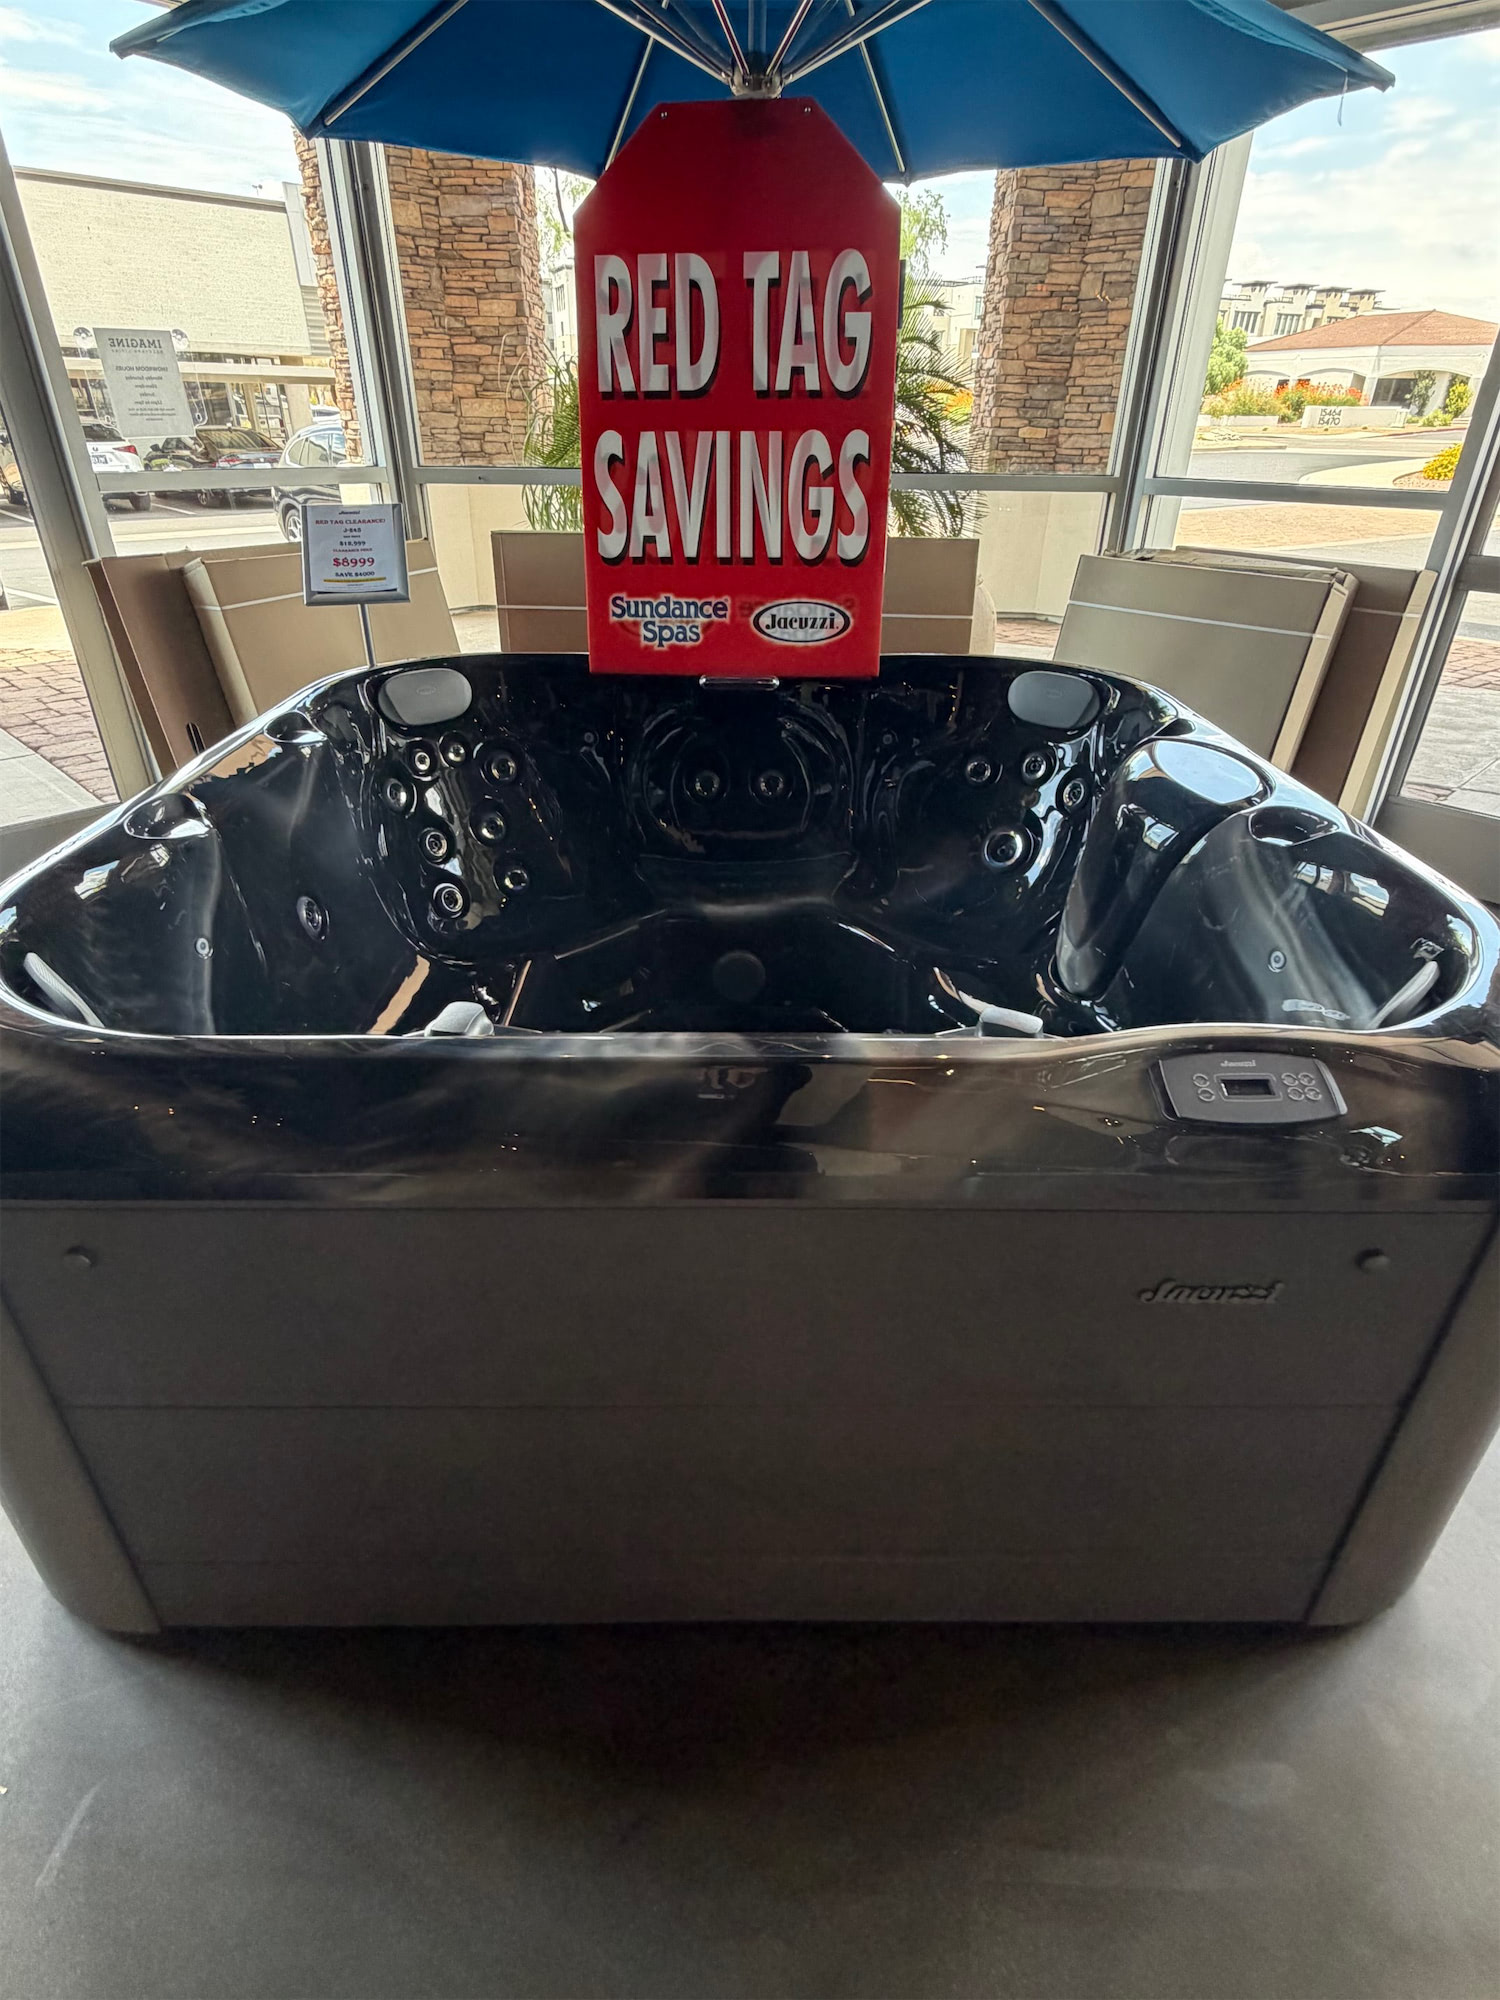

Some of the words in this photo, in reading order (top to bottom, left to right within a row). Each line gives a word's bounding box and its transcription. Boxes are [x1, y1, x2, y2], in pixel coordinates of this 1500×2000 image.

[594, 252, 721, 398] RED
[743, 248, 873, 398] TAG
[1318, 417, 1340, 425] 15470
[1320, 408, 1342, 416] 15464
[594, 428, 871, 566] SAVINGS
[332, 557, 374, 567] $8999
[610, 595, 729, 619] Sundance
[764, 612, 836, 630] Jacuzzi
[642, 621, 701, 648] Spas
